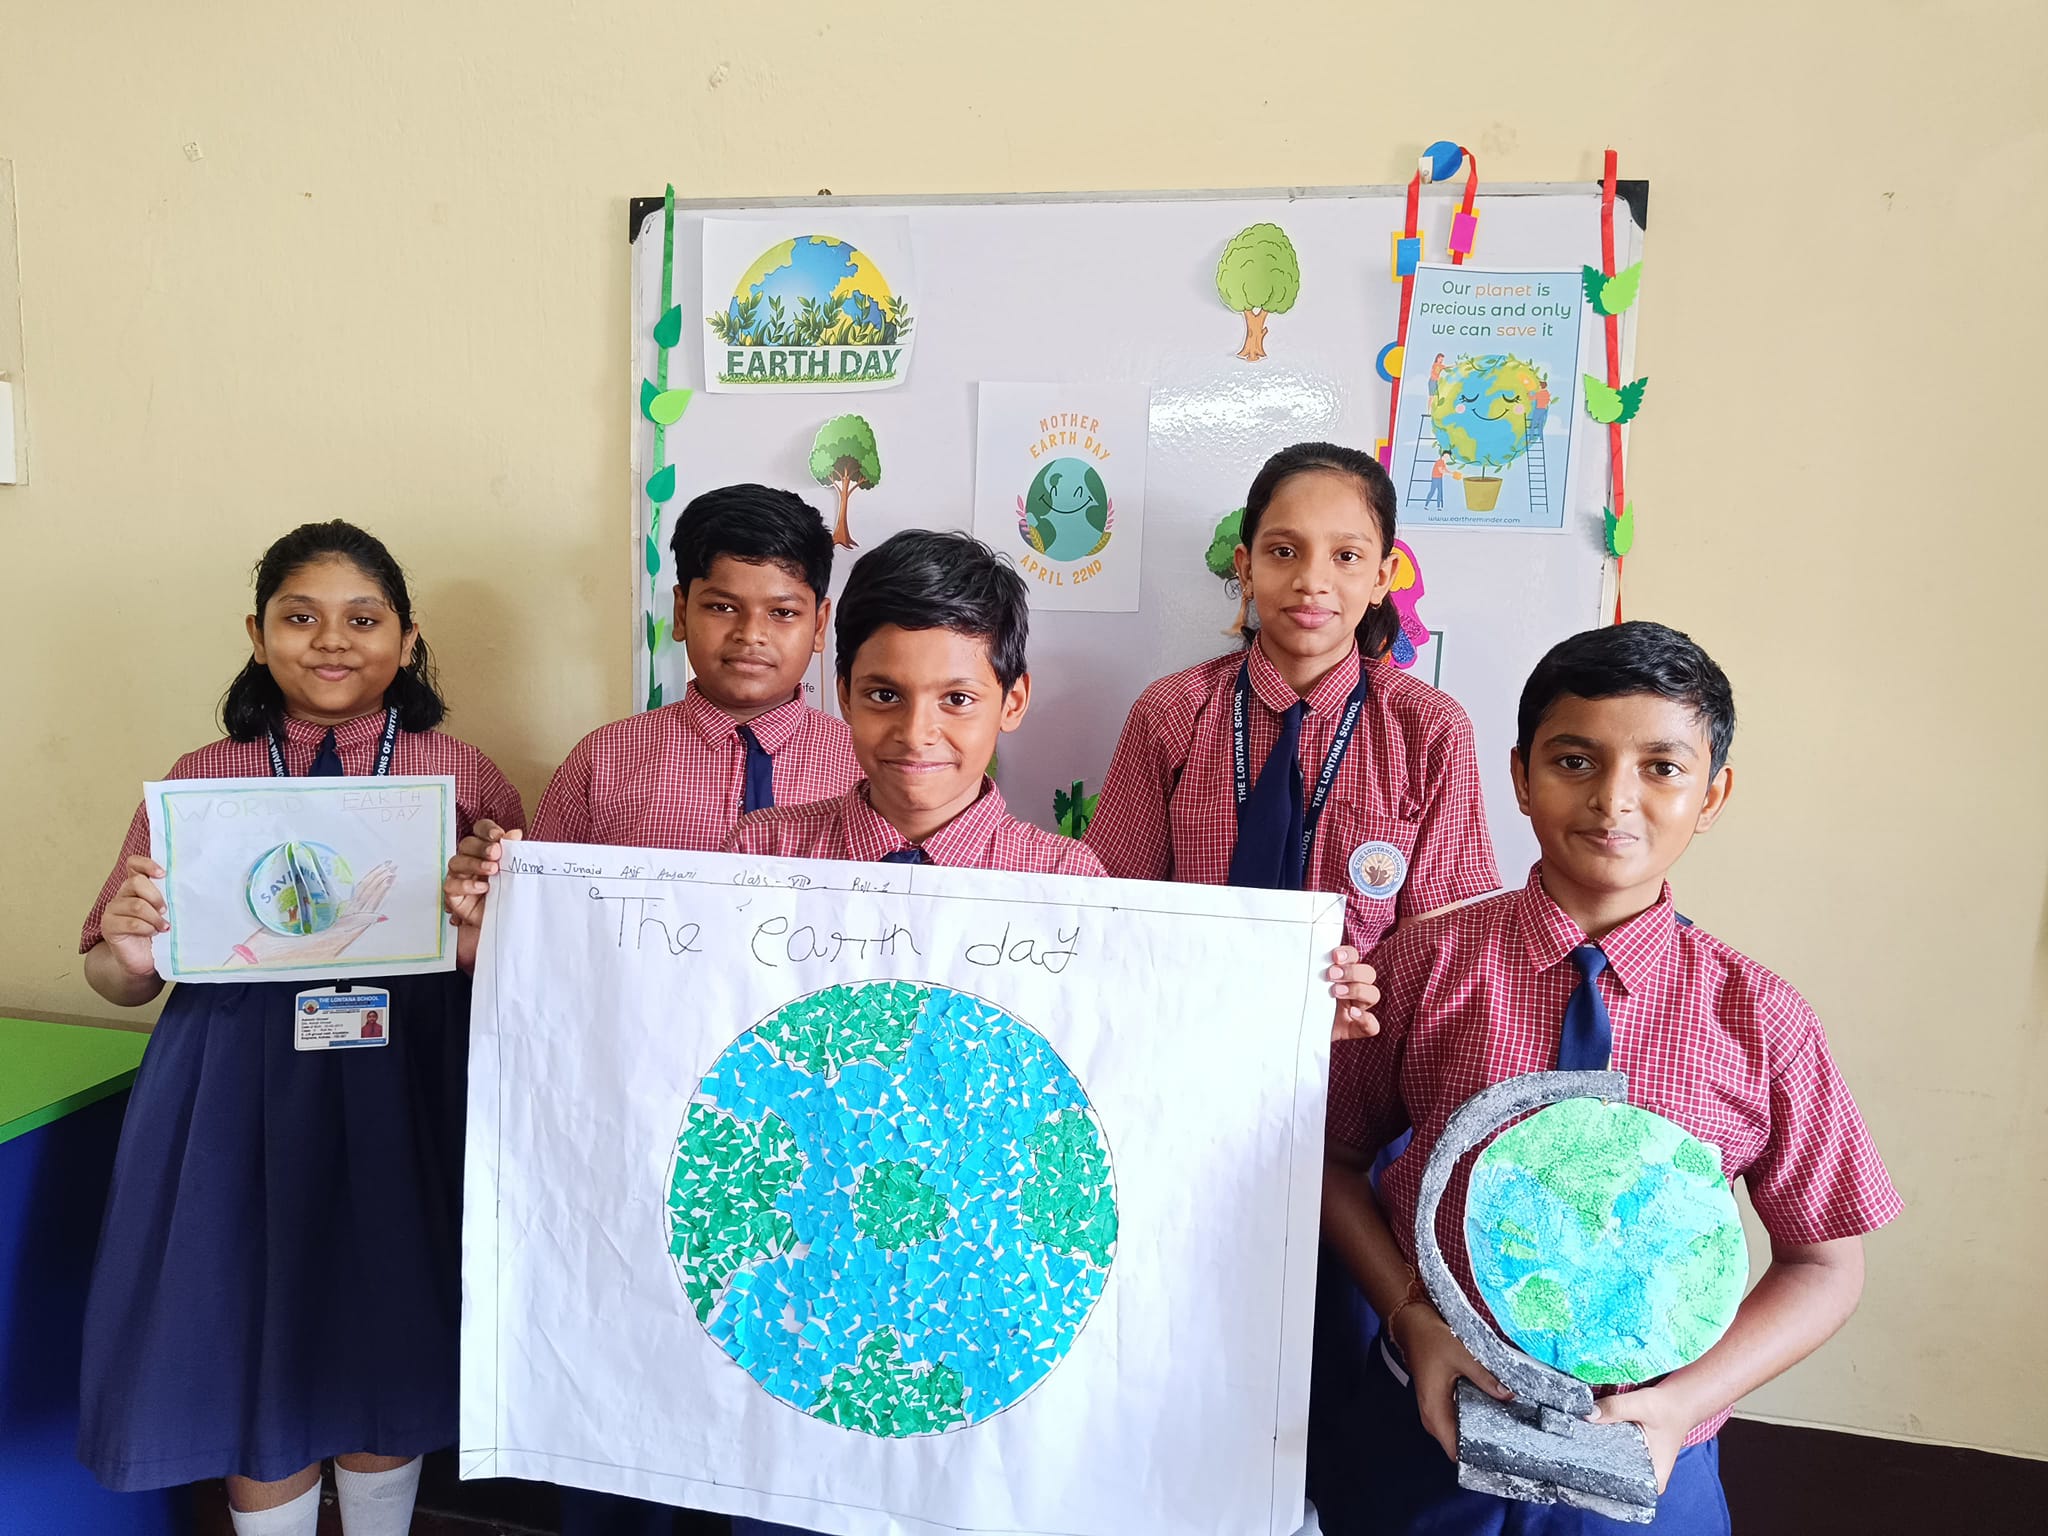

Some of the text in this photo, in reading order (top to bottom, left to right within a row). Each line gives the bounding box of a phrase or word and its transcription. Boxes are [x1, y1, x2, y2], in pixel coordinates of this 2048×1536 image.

[1442, 280, 1550, 299] Our planet is
[1420, 301, 1571, 319] precious and only
[1432, 322, 1553, 337] we can save it
[727, 349, 903, 378] EARTH DAY
[1039, 413, 1100, 433] MOTHER
[1029, 431, 1111, 460] EARTH DAY
[1428, 515, 1521, 524] www.earthreminder.com
[1020, 554, 1103, 587] APRIL 22ND
[386, 706, 399, 740] VIRTUE
[382, 740, 392, 754] OF
[1234, 689, 1247, 803] THE LONTANA SCHOOL
[1312, 700, 1361, 808] THE LONTANA SCHOOL
[342, 791, 422, 809] EARTH
[381, 807, 421, 823] DAY
[508, 856, 544, 875] Name
[563, 862, 603, 875] Junaid
[589, 887, 703, 955] The
[965, 922, 1079, 973] day
